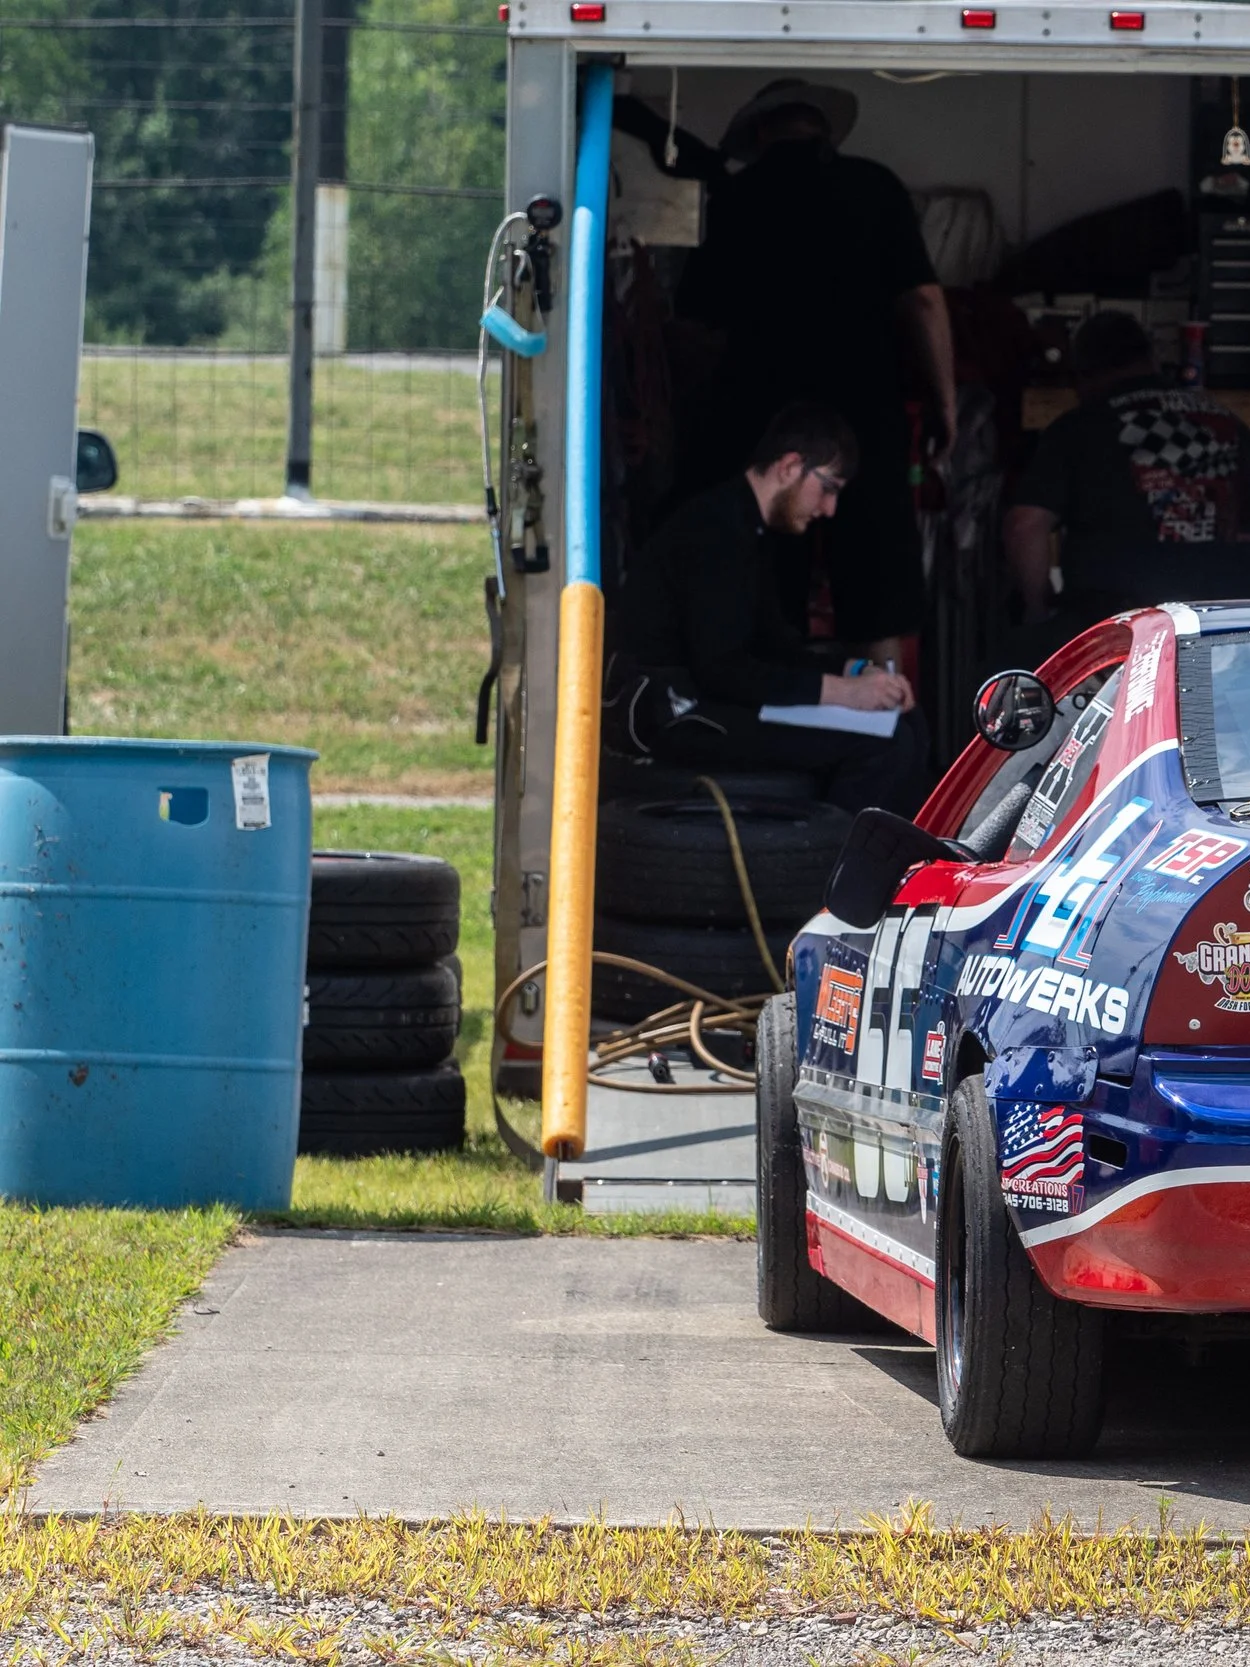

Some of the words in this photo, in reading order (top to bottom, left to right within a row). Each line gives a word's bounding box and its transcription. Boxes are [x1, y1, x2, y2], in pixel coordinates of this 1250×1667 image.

[1146, 829, 1247, 878] TSP
[955, 954, 1130, 1035] AUTOWERKS
[1216, 998, 1239, 1010] DASH
[1011, 1180, 1068, 1197] CREATIONS
